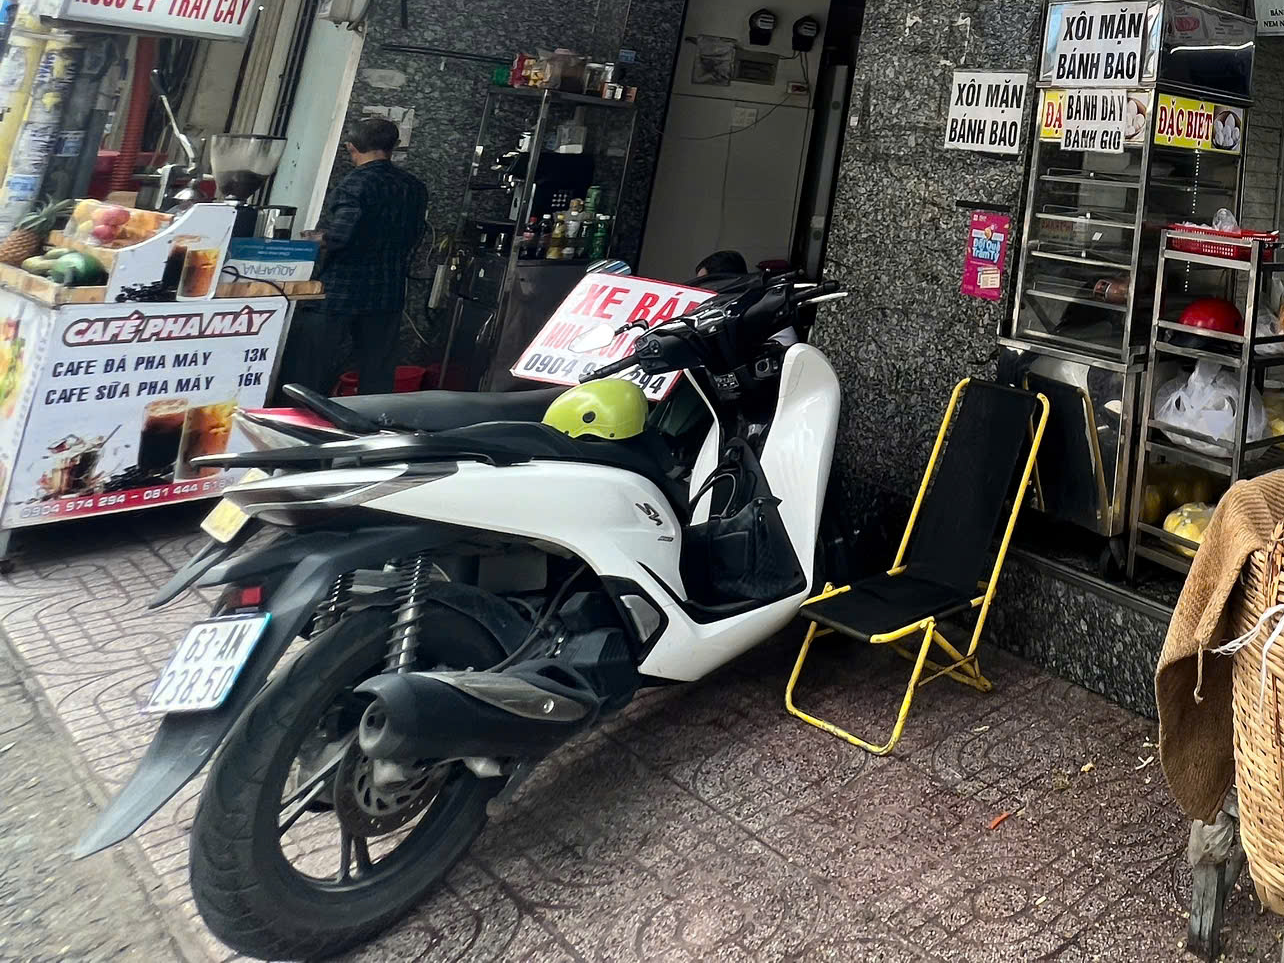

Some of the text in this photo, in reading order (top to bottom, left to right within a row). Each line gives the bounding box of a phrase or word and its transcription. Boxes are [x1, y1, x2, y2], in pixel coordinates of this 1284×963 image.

[1063, 8, 1143, 45] XÔI MẶN
[1056, 47, 1136, 79] BÁNH BAO
[955, 79, 1024, 113] XÔI MẶN
[1067, 91, 1124, 122] BÁNH DÀY
[948, 113, 1018, 147] BÁNH BAO
[1045, 95, 1063, 134] ĐẶ
[1157, 100, 1213, 146] ĐẶC BIỆT
[1064, 126, 1121, 150] BÁNH GIÒ
[571, 284, 631, 319] XE
[64, 306, 272, 345] CAFÉ PHA MÁY
[52, 348, 269, 377] CAFE ĐÁ PHA MÁY 13K
[523, 354, 576, 377] 0904
[44, 372, 263, 405] CAFE SỮA PHA MÁY 16K
[65, 498, 94, 512] 974
[98, 494, 126, 507] 294
[143, 488, 169, 500] 081
[173, 483, 198, 495] 444
[150, 666, 235, 706] 238.50
